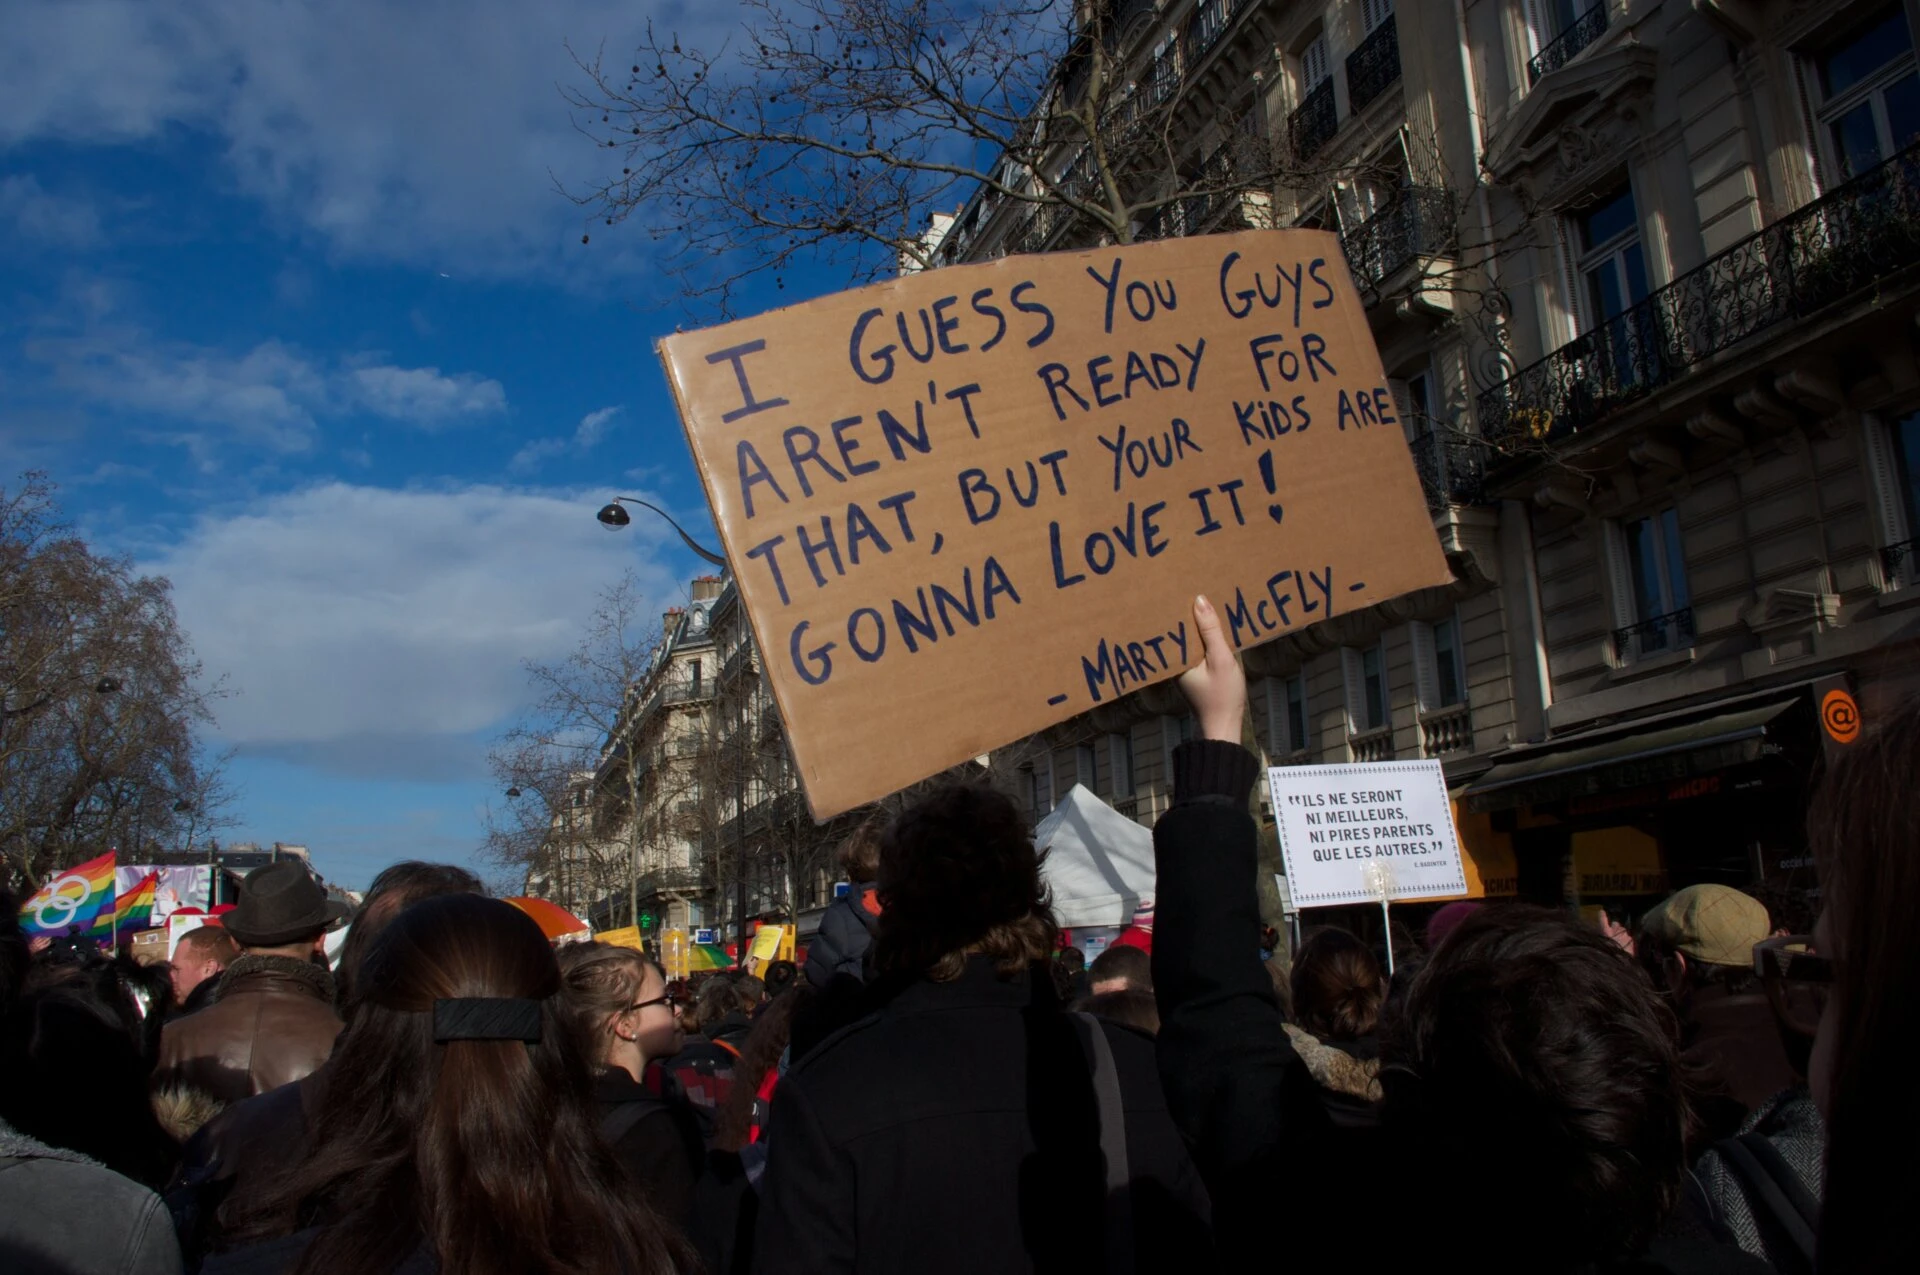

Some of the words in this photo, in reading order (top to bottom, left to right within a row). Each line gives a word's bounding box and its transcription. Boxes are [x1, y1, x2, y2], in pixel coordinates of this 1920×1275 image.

[705, 339, 790, 424] I
[850, 281, 1055, 385] GUESS
[1086, 257, 1177, 334] YOU
[1220, 251, 1334, 328] GUYS
[736, 380, 982, 520] AREN'T
[1037, 337, 1206, 421] READY
[1249, 333, 1337, 392] FOR
[745, 490, 944, 606] THAT,
[957, 449, 1069, 526] BUT
[1097, 417, 1203, 492] YOUR
[1337, 387, 1397, 431] ARE
[789, 555, 1022, 686] GONNA
[1049, 501, 1169, 590] LOVE
[1081, 620, 1188, 703] MARTY
[1224, 566, 1333, 649] McFLY
[1305, 811, 1323, 826] NI
[1325, 806, 1409, 824] MEILLEURS,
[1308, 830, 1326, 844] NI
[1329, 826, 1371, 842] PIRES
[1373, 823, 1435, 840] PARENTS
[1312, 848, 1343, 863] QUE
[1345, 844, 1373, 860] LES
[1328, 792, 1349, 806] NE
[1351, 789, 1404, 805] SERONT
